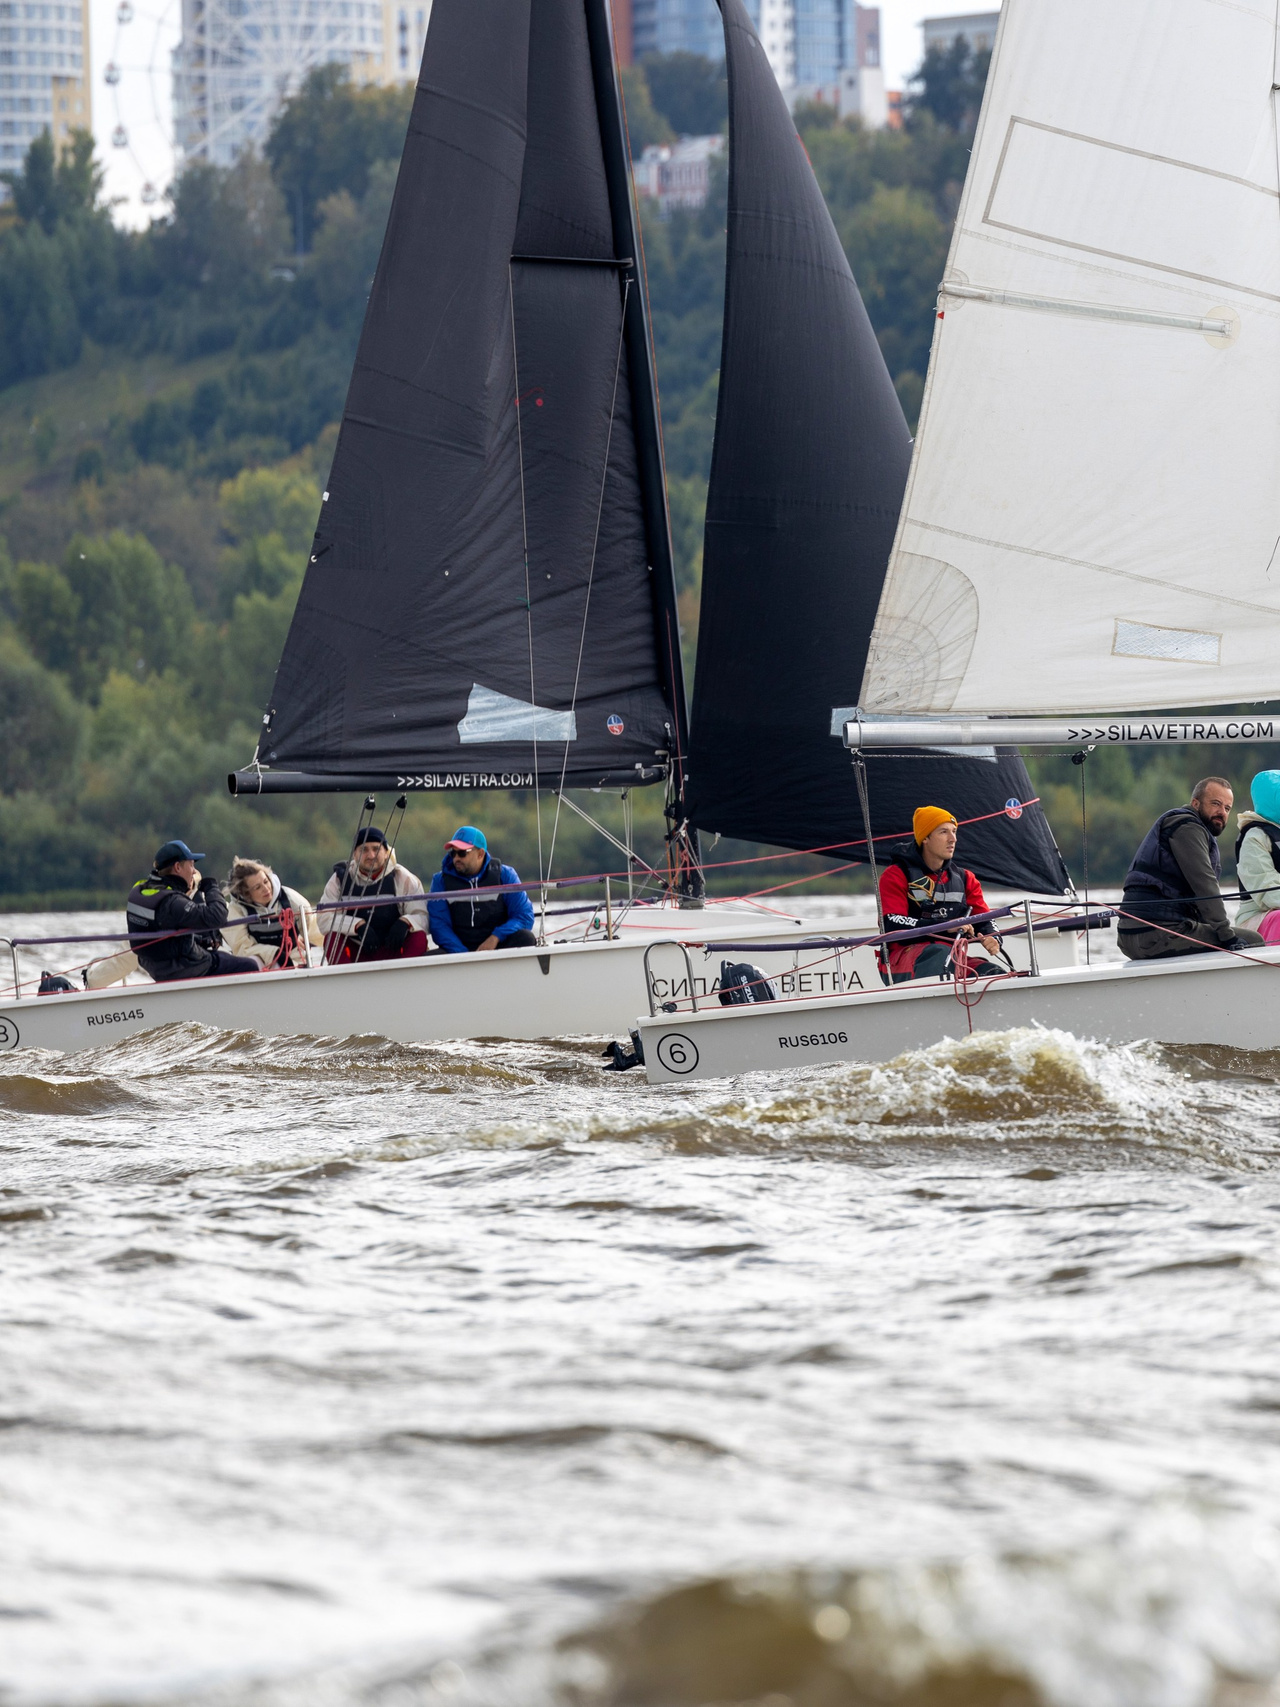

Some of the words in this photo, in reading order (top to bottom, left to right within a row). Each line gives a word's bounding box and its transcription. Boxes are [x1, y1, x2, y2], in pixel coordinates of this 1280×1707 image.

[781, 970, 864, 993] ВЕТРА
[87, 1008, 145, 1026] RUS6145
[778, 1031, 848, 1049] RUS6106
[669, 1042, 688, 1064] 6
